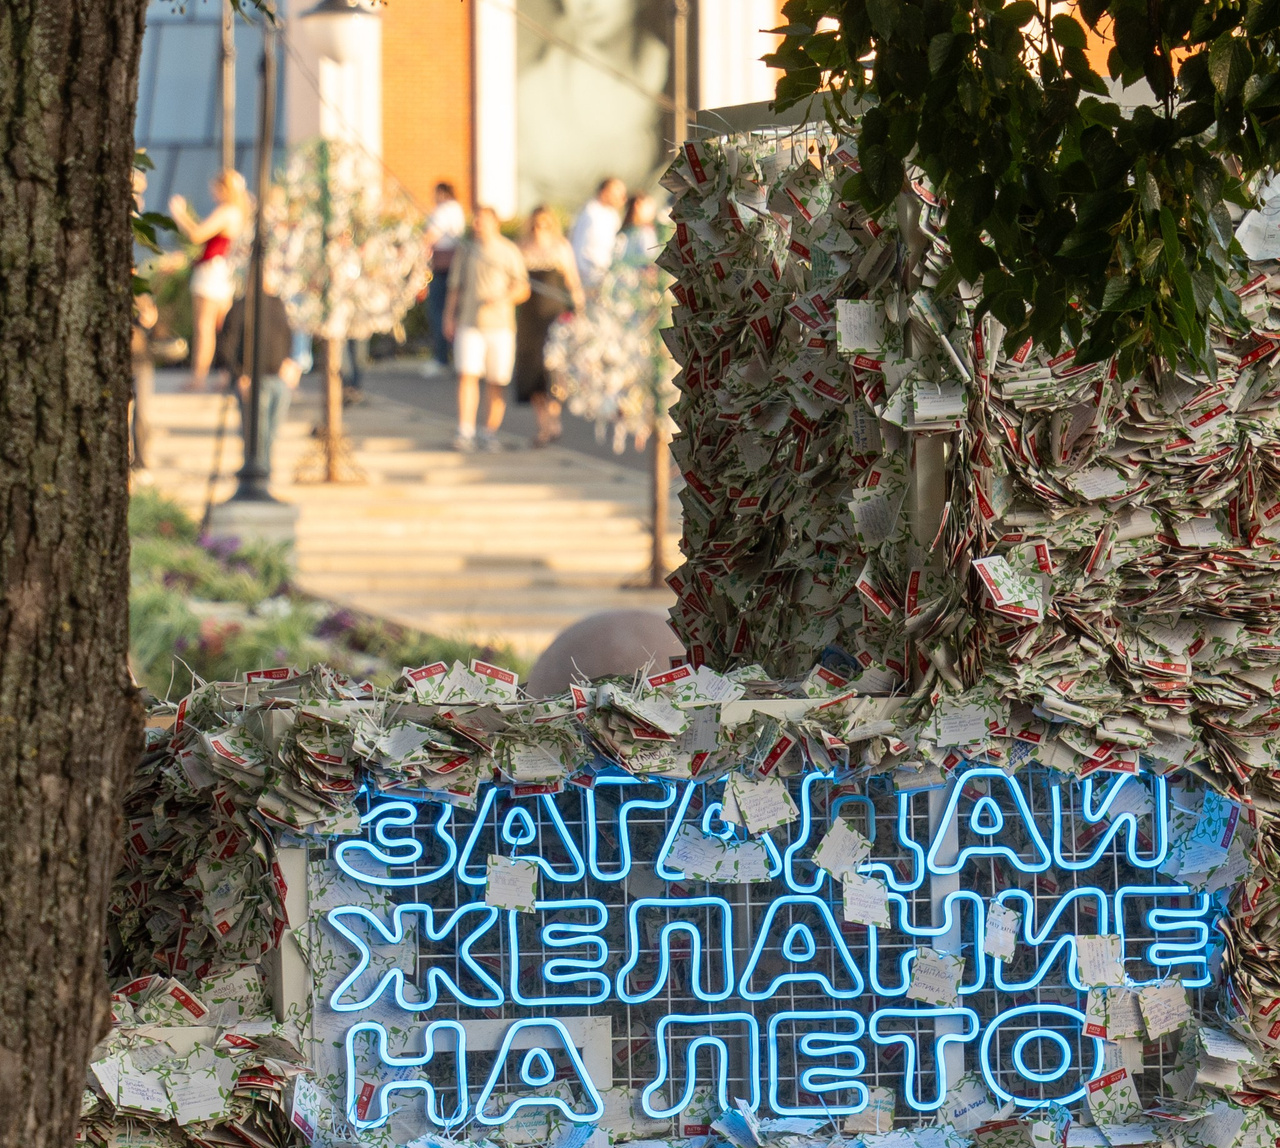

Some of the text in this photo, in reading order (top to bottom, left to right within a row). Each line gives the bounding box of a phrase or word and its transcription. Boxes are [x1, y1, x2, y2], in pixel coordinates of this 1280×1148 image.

[327, 885, 1212, 1012] ЖЕЛАНИЕ
[345, 1003, 1104, 1128] НА ЛЕТО
